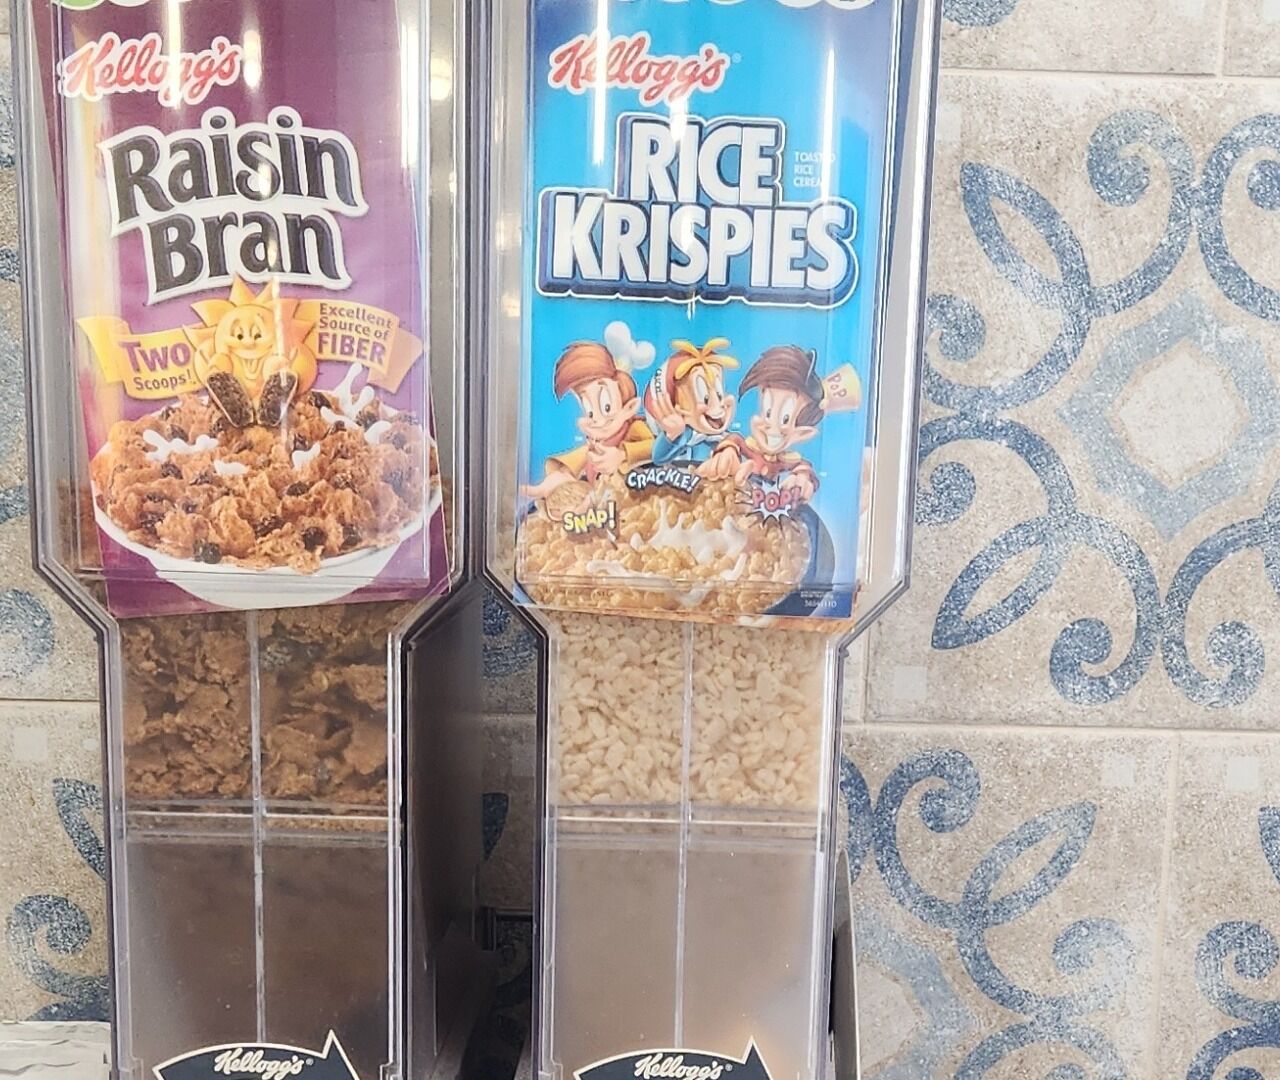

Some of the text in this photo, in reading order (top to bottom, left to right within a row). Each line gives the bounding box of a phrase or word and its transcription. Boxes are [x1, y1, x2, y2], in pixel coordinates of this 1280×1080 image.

[64, 33, 240, 104] Kellog's
[106, 112, 362, 222] Raisin
[628, 121, 778, 204] RICE
[793, 150, 836, 163] TOASTD
[793, 176, 824, 188] CEREA
[146, 210, 342, 294] Bran
[550, 194, 848, 291] KRISPIES
[319, 302, 393, 329] Excellent
[319, 316, 390, 341] Source of
[318, 332, 386, 365] FIBER
[132, 369, 198, 392] Scoops!
[626, 465, 701, 493] CRACKLE!
[752, 487, 803, 513] POP!
[563, 501, 617, 533] SNAP!
[213, 1046, 305, 1080] Kellogg's
